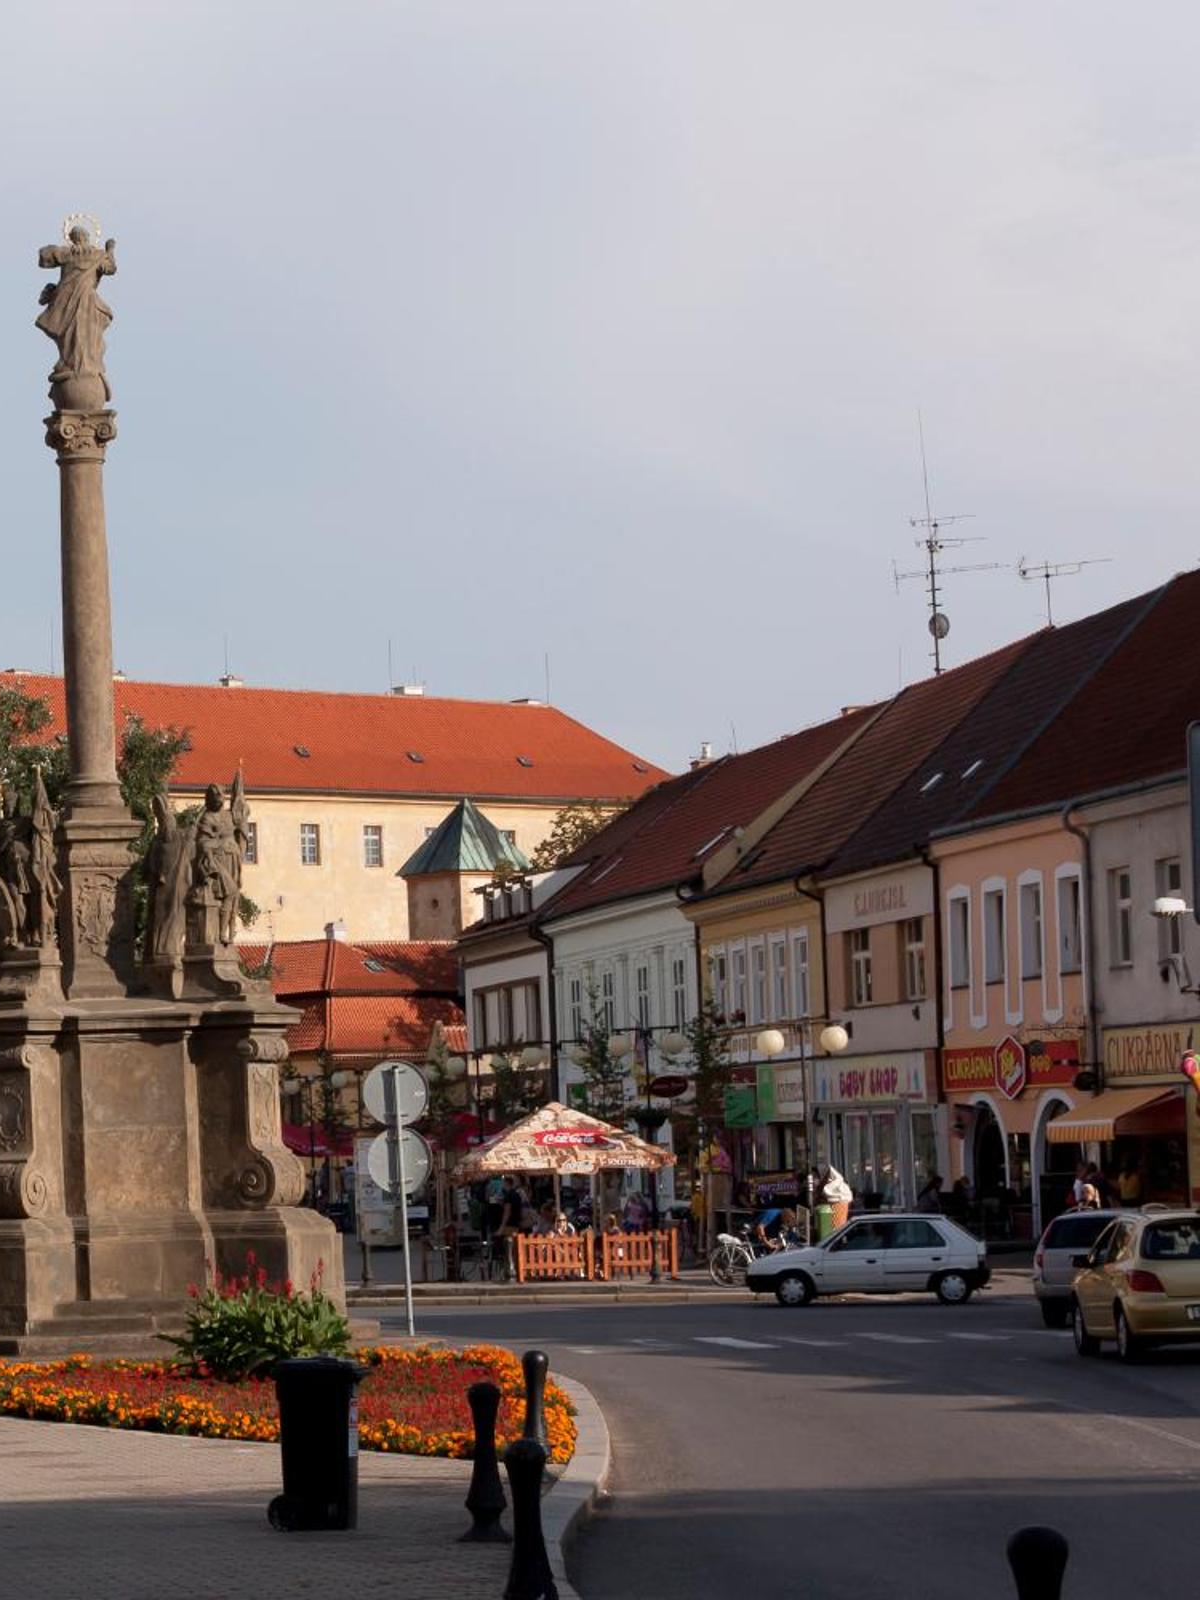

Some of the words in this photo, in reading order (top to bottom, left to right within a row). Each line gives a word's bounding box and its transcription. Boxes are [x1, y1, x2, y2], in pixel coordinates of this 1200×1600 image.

[947, 1051, 994, 1080] CUKRÁRNA
[1107, 1029, 1181, 1076] CUKRÁRNA
[870, 1064, 898, 1096] SHOP
